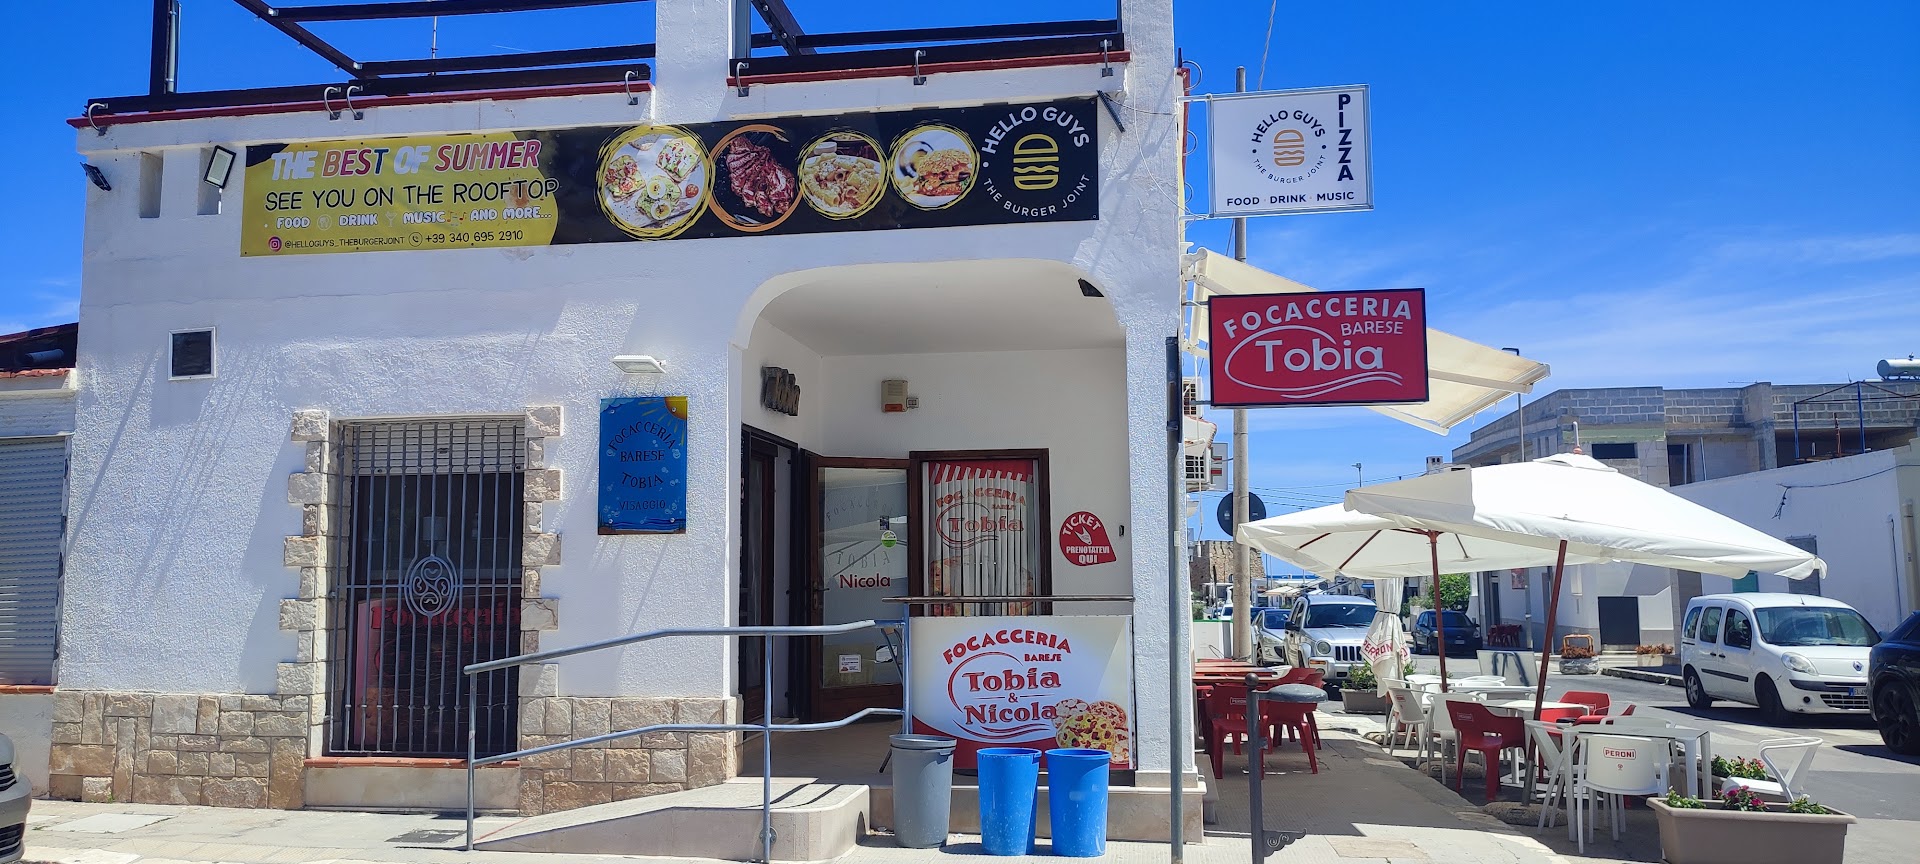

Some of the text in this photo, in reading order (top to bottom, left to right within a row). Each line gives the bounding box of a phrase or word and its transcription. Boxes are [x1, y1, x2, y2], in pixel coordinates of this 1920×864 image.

[981, 106, 1090, 154] HELLO GUYS
[1251, 110, 1326, 143] HELLO GUYS
[1337, 93, 1354, 181] PIZZA
[271, 139, 542, 180] THE BEST OF SUMMER
[1253, 154, 1327, 184] THE BURGER JOINT
[265, 179, 559, 211] SEE YOU ON THE ROOFTOP
[983, 174, 1090, 217] THE BURGER JOINT
[1227, 191, 1355, 206] FOOD DRINK MUSIC
[276, 206, 552, 229] FOOD DRINK MUSIC AND MORE...
[425, 229, 524, 244] +39 340 695 2910
[1223, 297, 1412, 340] FOCACCERIA
[1340, 320, 1404, 337] BARESE
[1254, 337, 1384, 373] Tobia
[608, 421, 676, 451] FOCACCERIA
[620, 449, 665, 462] BARESE
[621, 471, 664, 488] TOBIA
[946, 516, 1025, 532] Tobia
[1062, 514, 1102, 535] TICKET
[1066, 545, 1110, 554] PRENOTATEVI
[1078, 554, 1098, 564] QUI
[840, 573, 891, 589] Nicola
[942, 629, 1072, 665] FOCACCERIA
[1024, 653, 1062, 662] BARESE
[962, 667, 1062, 692] Tobia
[1008, 692, 1018, 703] &
[963, 701, 1058, 725] Nicola
[1605, 749, 1635, 758] PERONI
